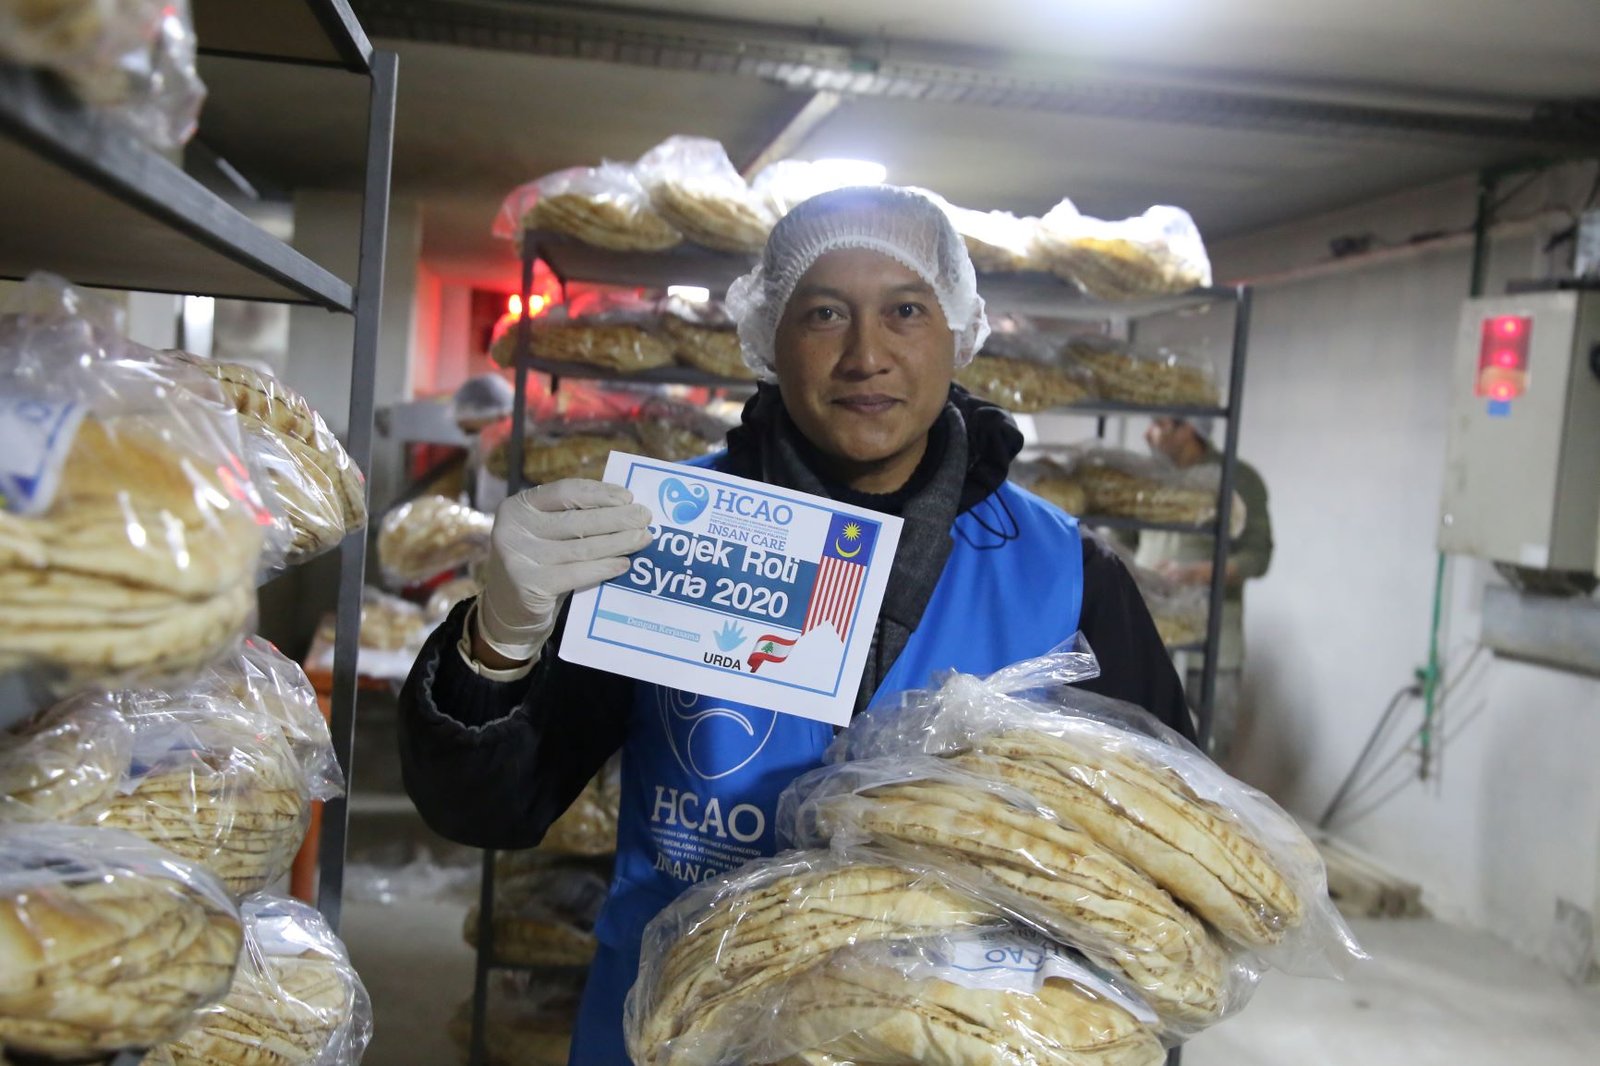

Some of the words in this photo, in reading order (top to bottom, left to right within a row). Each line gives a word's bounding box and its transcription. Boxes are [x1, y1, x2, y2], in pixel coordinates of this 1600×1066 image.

[713, 489, 793, 525] HCAO
[707, 523, 749, 542] INSAN
[751, 534, 787, 551] CARE
[741, 545, 800, 584] Roti
[630, 557, 707, 598] Syria
[711, 577, 788, 618] 2020
[703, 652, 741, 670] URDA
[651, 785, 765, 843] HCAO
